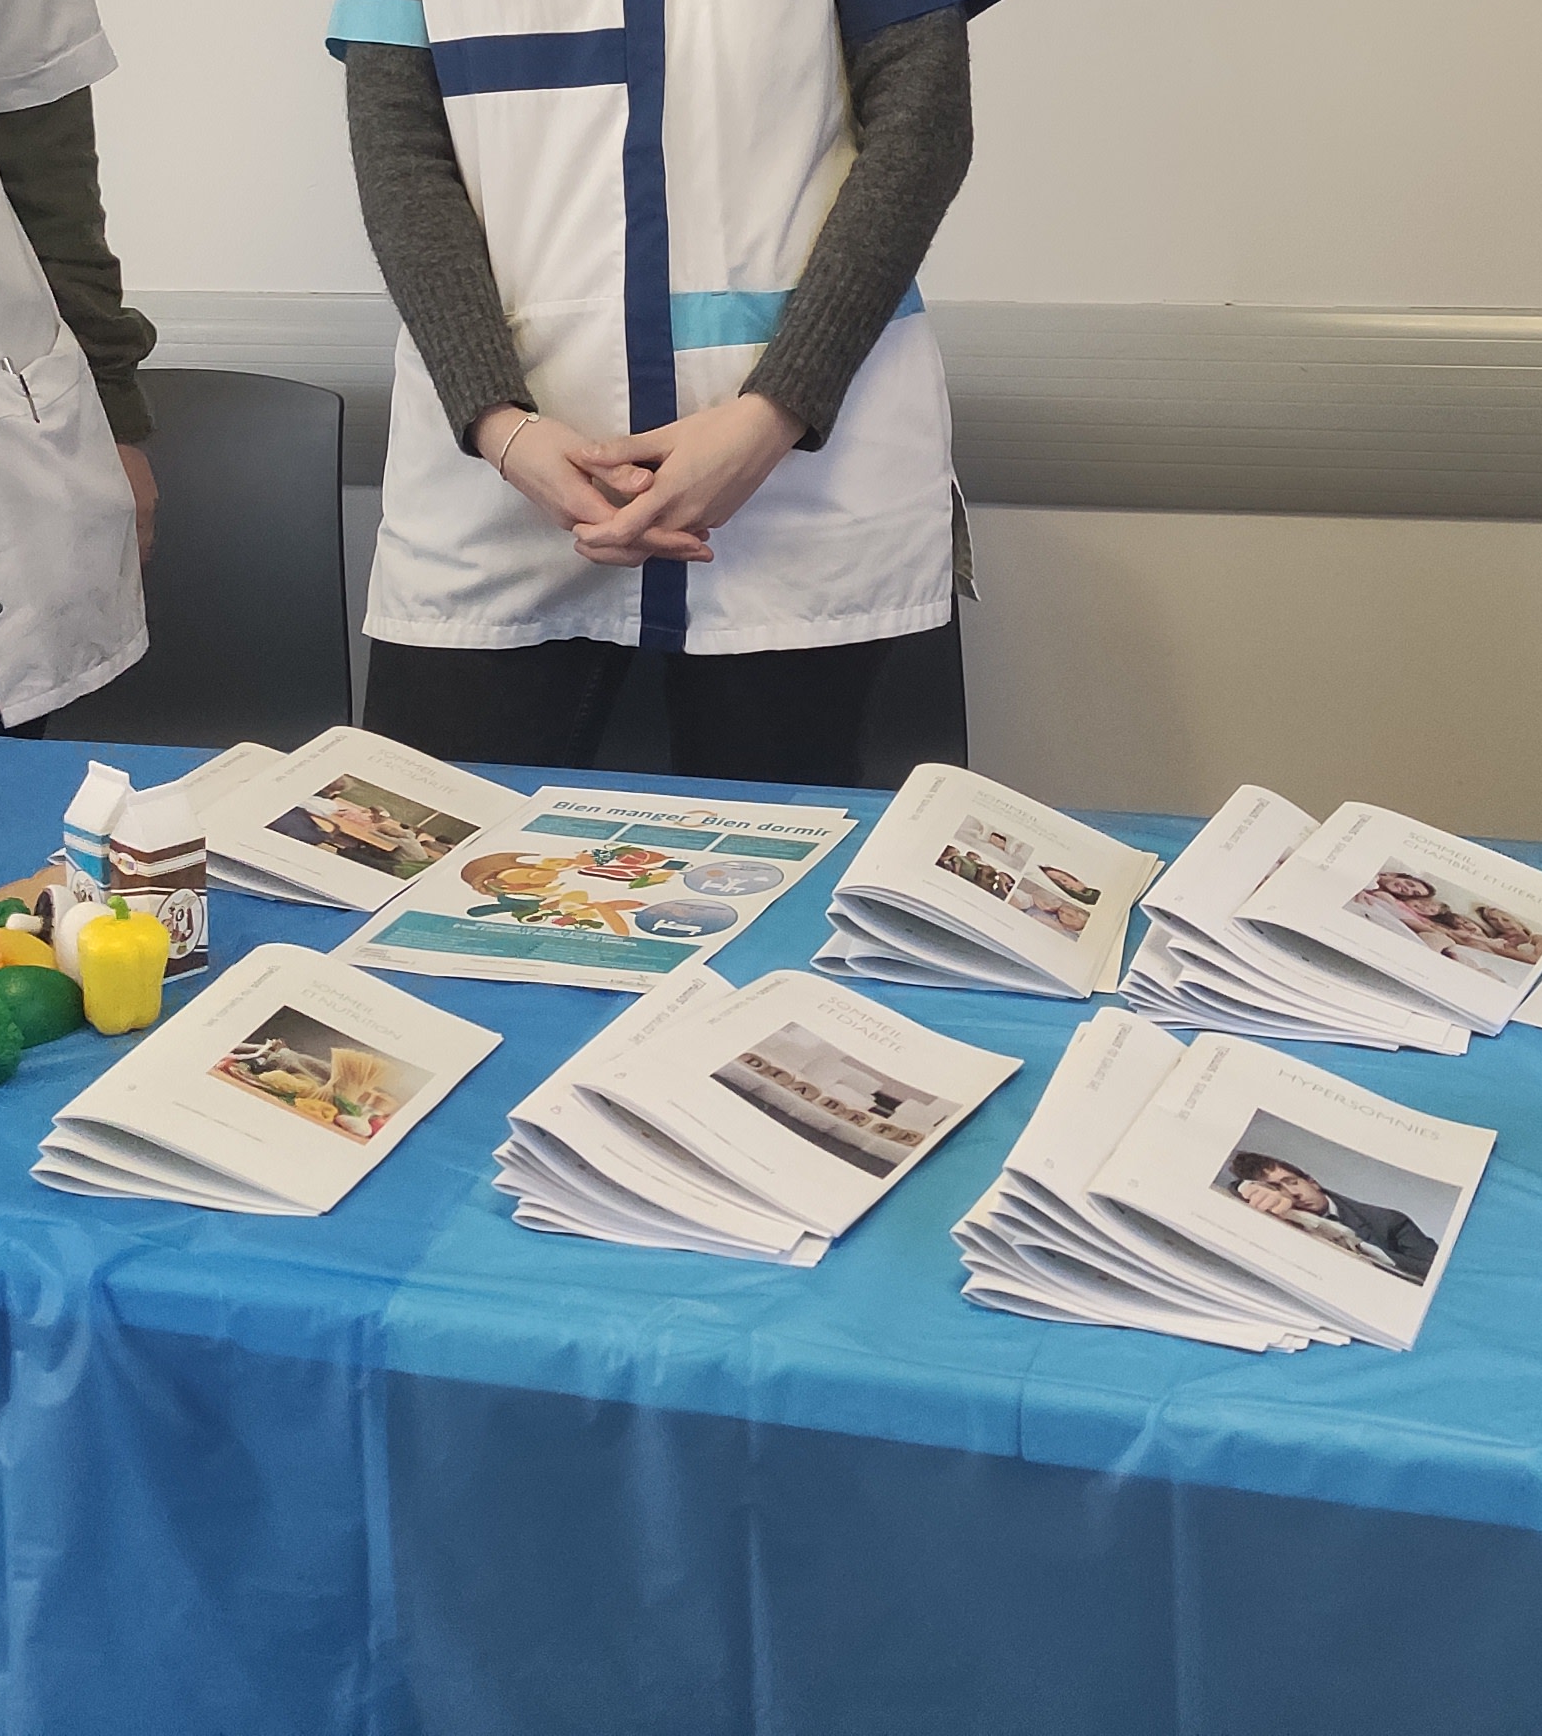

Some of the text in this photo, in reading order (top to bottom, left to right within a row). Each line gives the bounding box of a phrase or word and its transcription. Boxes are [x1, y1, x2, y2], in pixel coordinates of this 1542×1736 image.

[552, 801, 833, 838] Bien manger Bien dormir
[1278, 1067, 1441, 1142] HYPERSOMNIES
